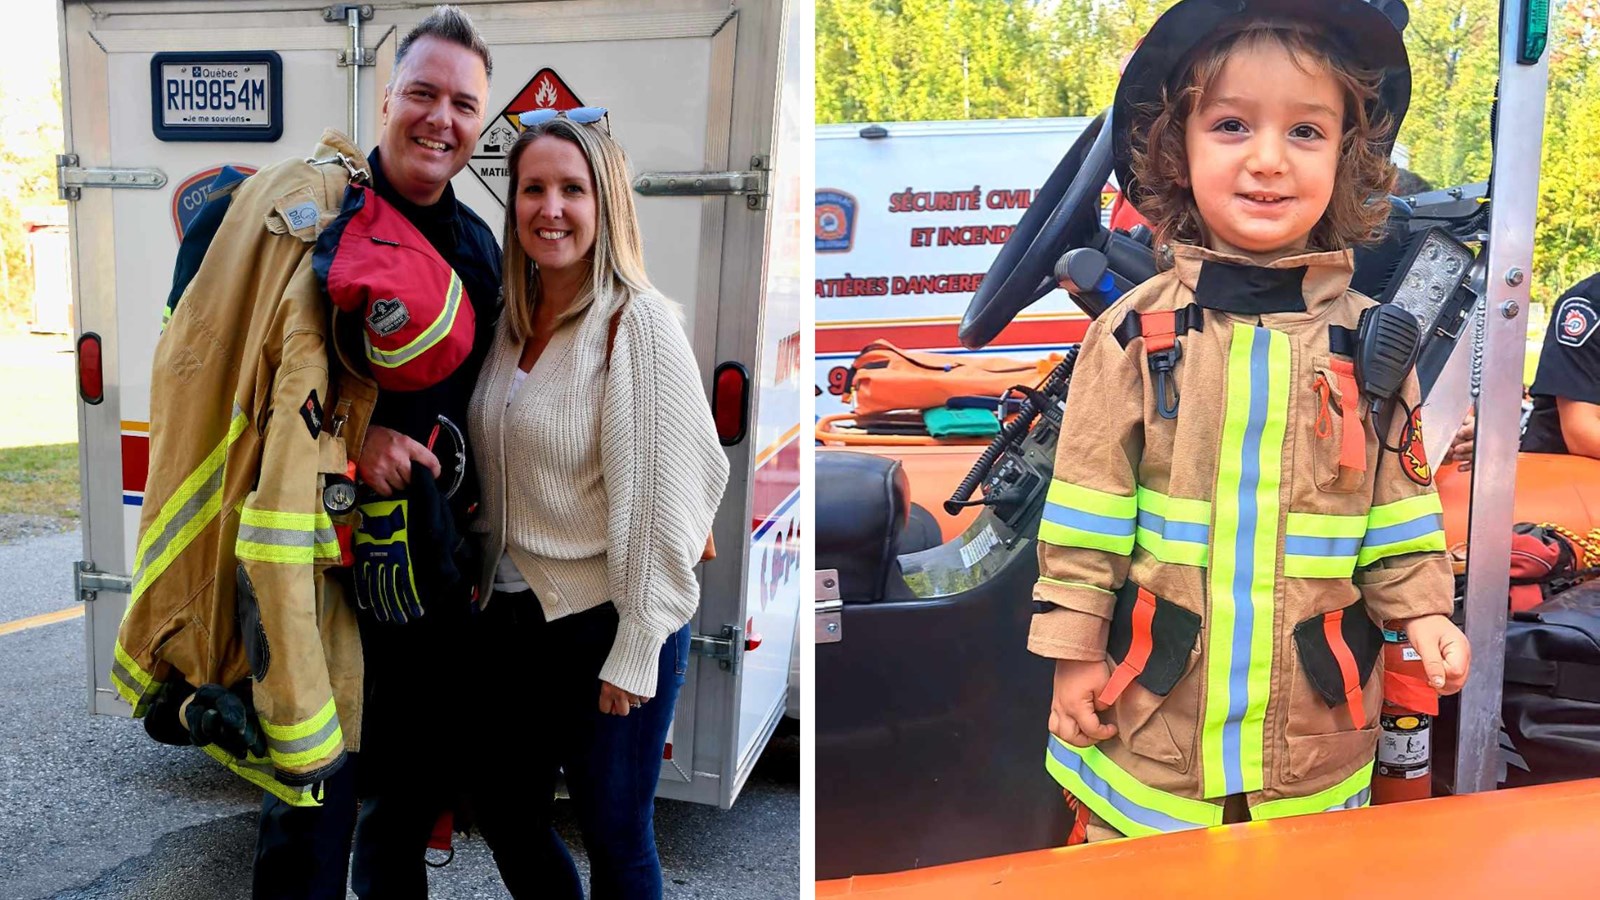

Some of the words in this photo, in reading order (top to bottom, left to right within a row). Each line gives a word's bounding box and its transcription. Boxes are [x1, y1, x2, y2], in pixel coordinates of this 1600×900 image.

[202, 68, 239, 78] Québec
[167, 79, 265, 110] RH9854M
[888, 185, 981, 213] SÉCURITÉ
[986, 188, 1040, 209] CIVIL
[911, 227, 936, 247] ET
